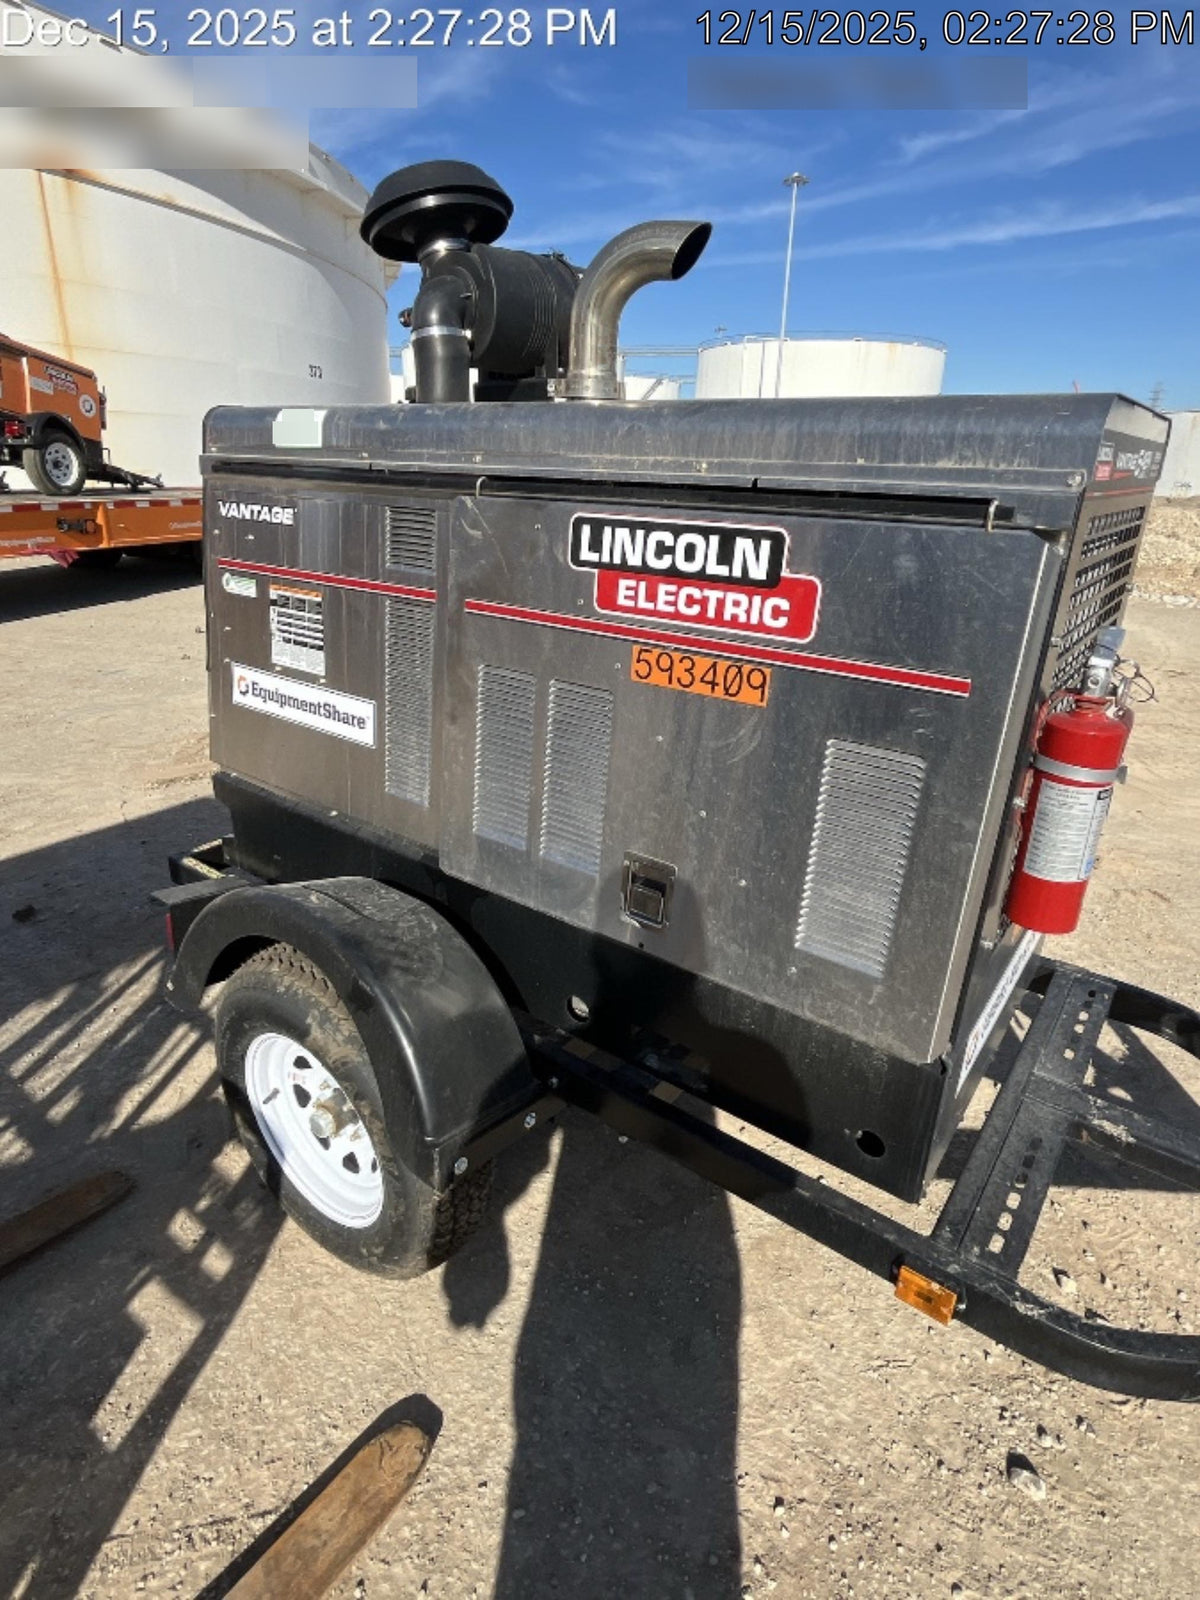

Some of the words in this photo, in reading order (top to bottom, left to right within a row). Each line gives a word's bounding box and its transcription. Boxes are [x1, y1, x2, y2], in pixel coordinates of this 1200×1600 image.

[218, 501, 295, 525] VANTAGE
[579, 524, 771, 580] LINCOLN
[616, 578, 790, 628] ELECTRIC
[634, 648, 768, 703] 593409
[250, 681, 367, 730] EquipmentShare
